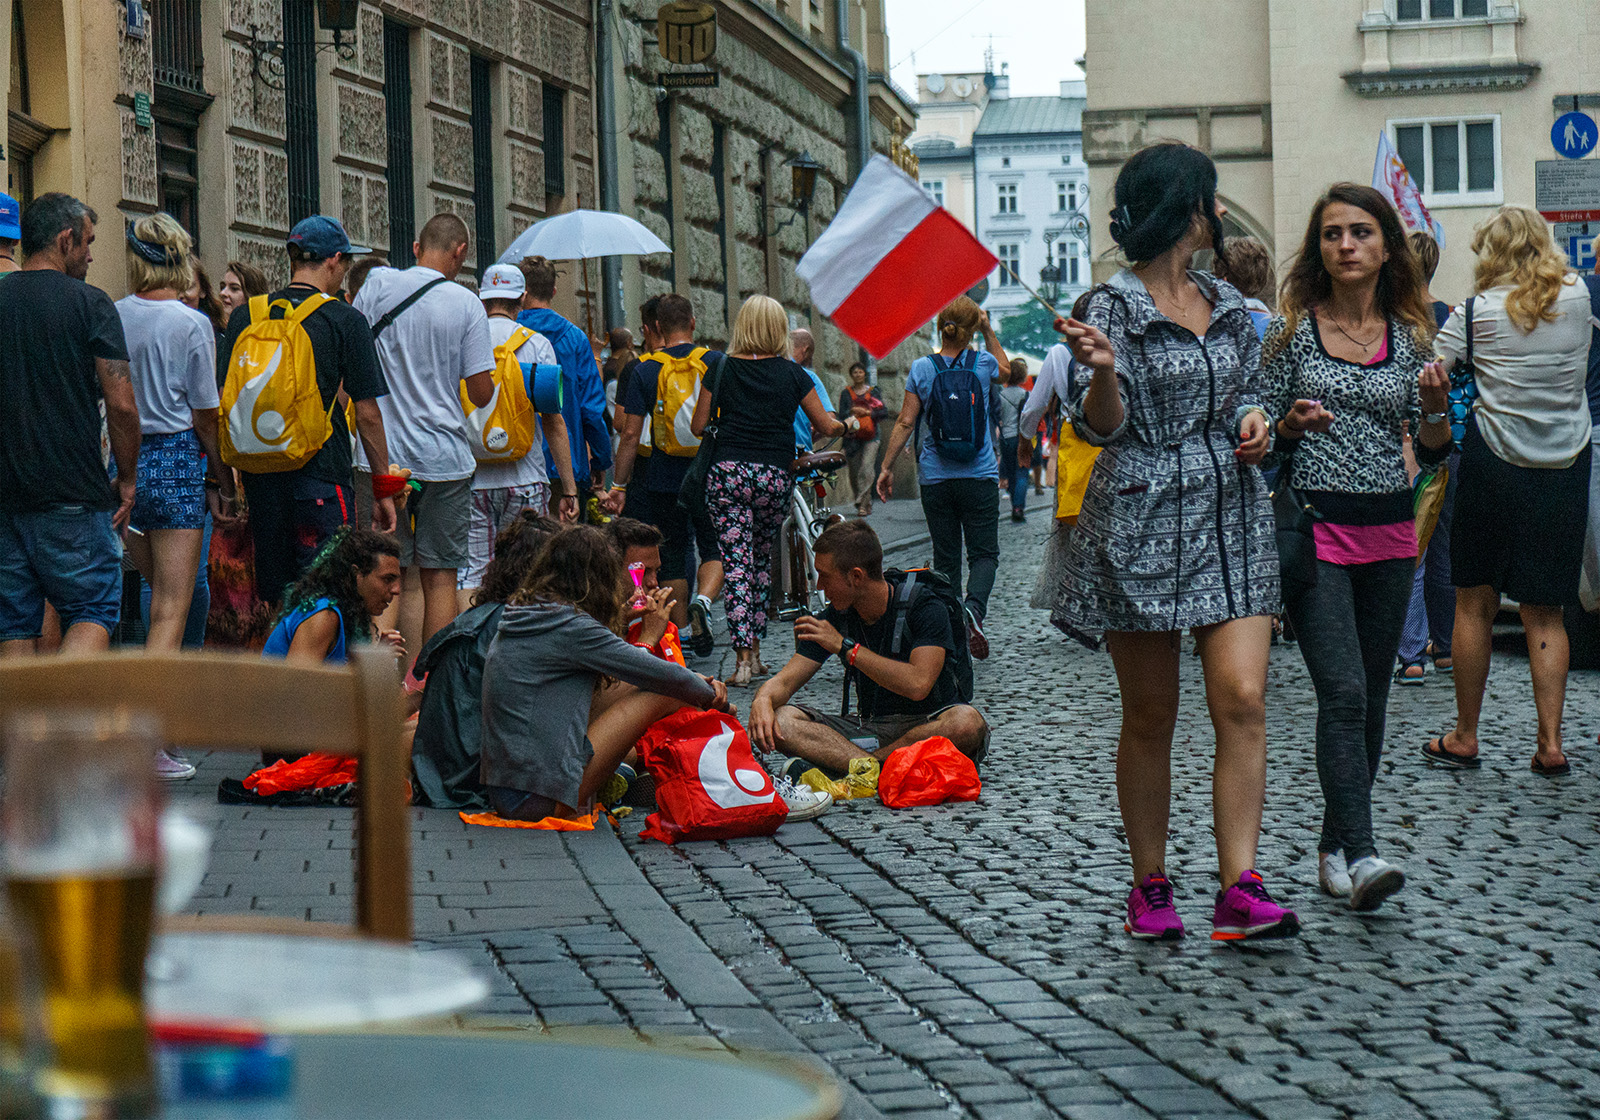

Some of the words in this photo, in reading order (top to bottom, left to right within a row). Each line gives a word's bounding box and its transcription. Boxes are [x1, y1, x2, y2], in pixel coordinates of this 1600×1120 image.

[663, 75, 714, 86] bankomat
[1560, 211, 1583, 221] Strefa
[1585, 212, 1592, 220] A
